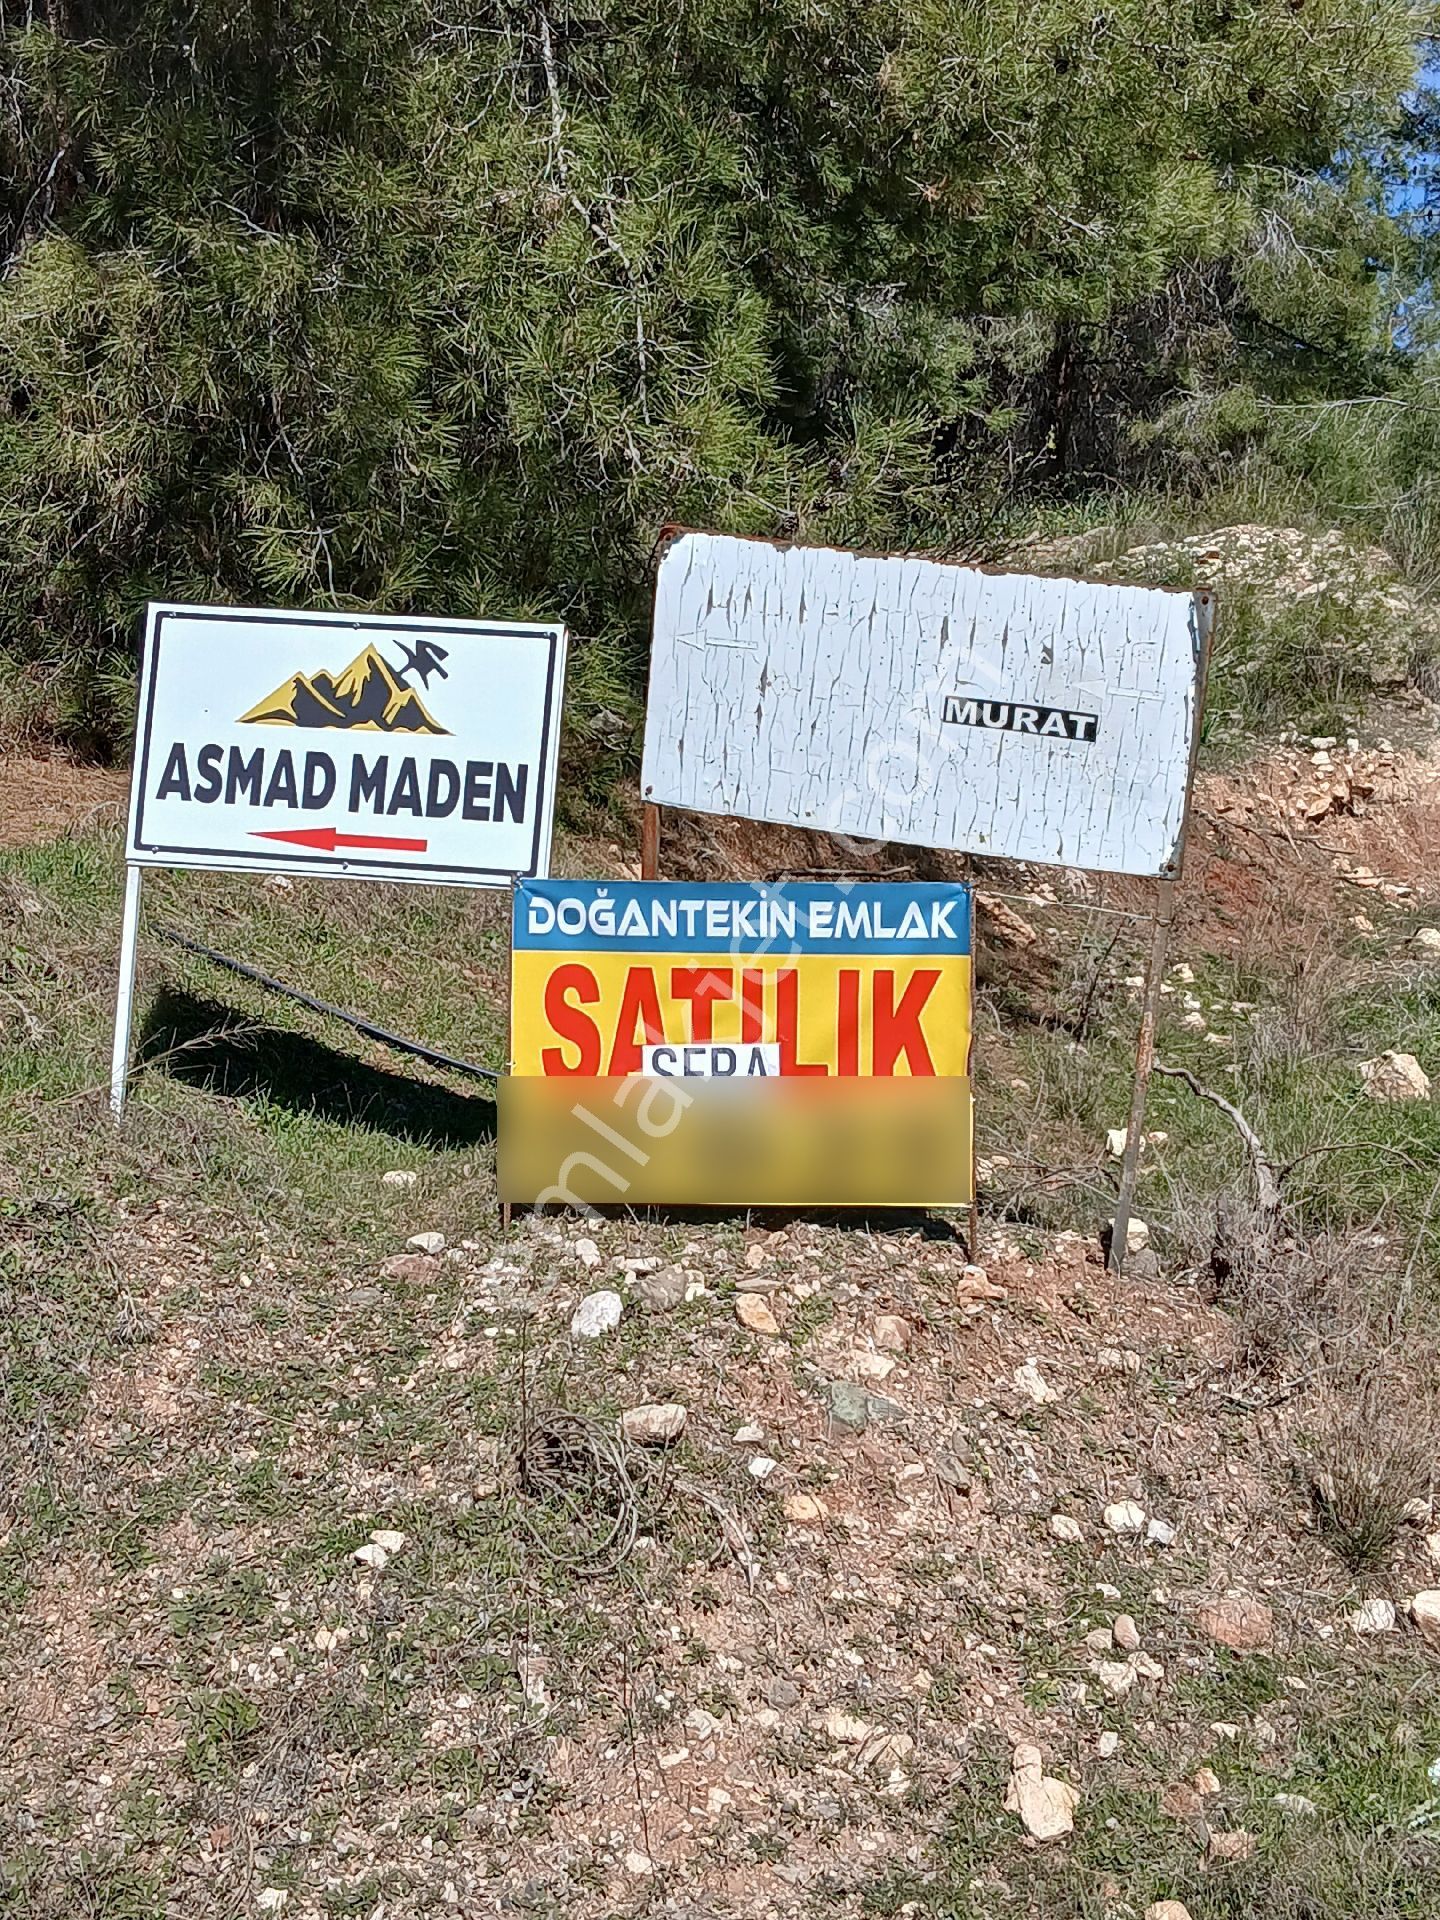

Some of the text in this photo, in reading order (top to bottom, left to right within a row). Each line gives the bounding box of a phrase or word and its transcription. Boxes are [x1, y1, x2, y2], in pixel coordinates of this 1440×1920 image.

[945, 698, 1097, 740] MURAT
[155, 742, 529, 823] ASMAD MADEN
[528, 888, 958, 938] DOĞANTEKİN EMLAK
[541, 963, 943, 1076] SATILIK
